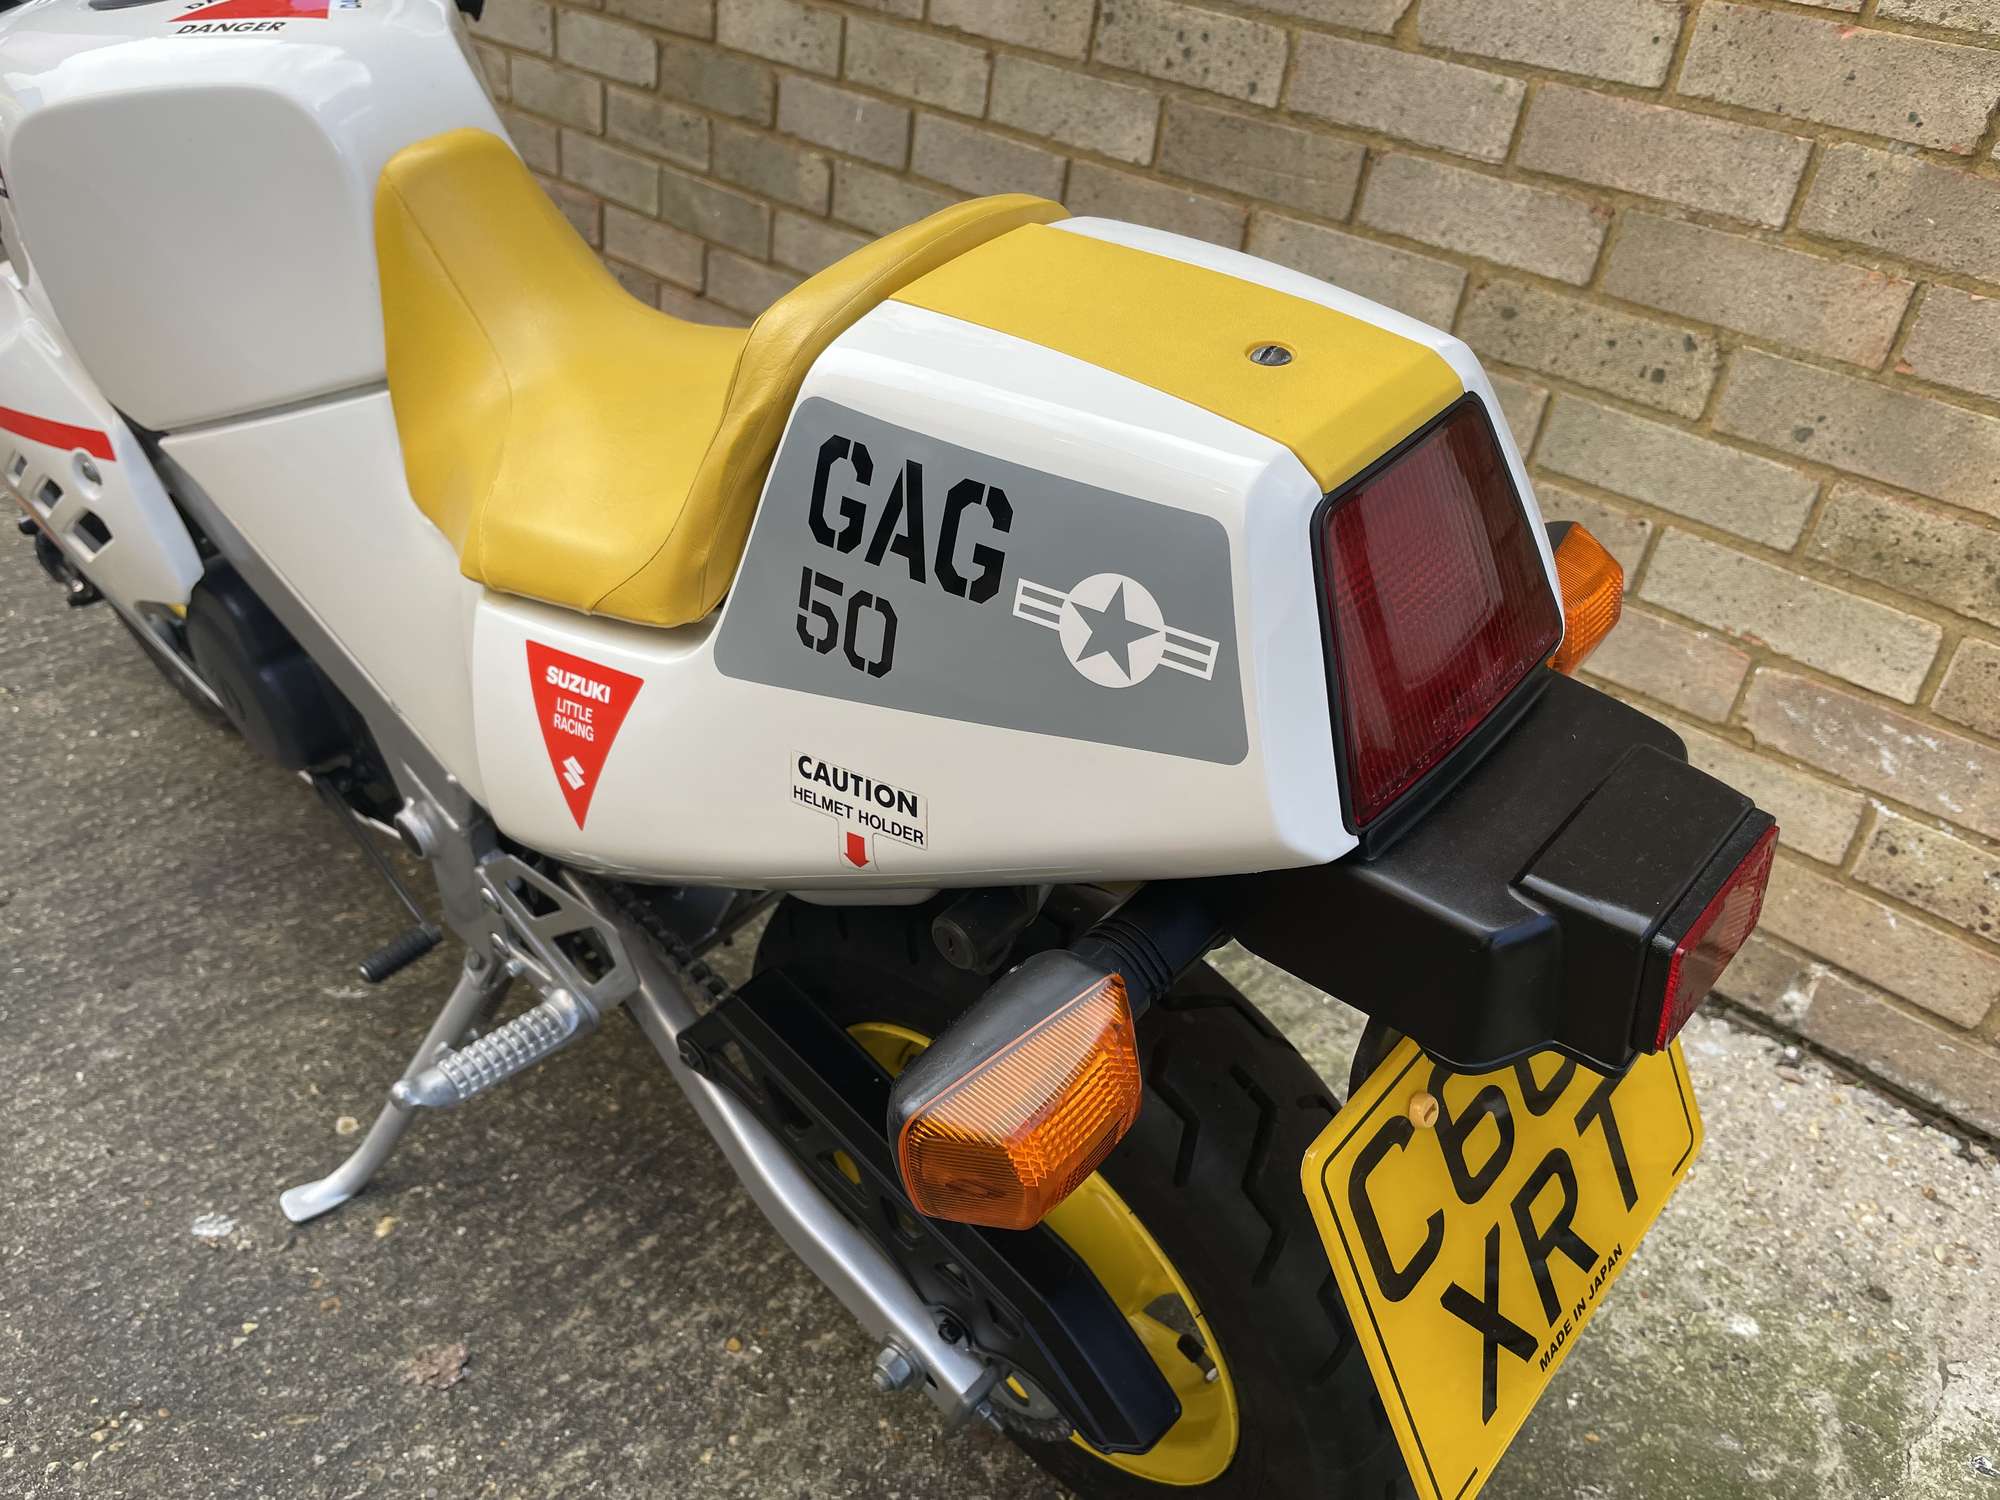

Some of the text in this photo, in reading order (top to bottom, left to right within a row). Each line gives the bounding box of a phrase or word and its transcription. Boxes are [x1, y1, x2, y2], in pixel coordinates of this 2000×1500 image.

[175, 21, 286, 35] DANGER
[808, 434, 1014, 605] GAG
[796, 566, 898, 679] 50
[545, 665, 611, 704] SUZUKI
[556, 697, 593, 724] LITTLE
[553, 713, 594, 743] RACING
[793, 785, 924, 845] HELMET HOLDER
[798, 755, 918, 818] CAUTION
[1440, 1077, 1638, 1426] XRT
[1539, 1242, 1623, 1373] MADE IN JAPAN
